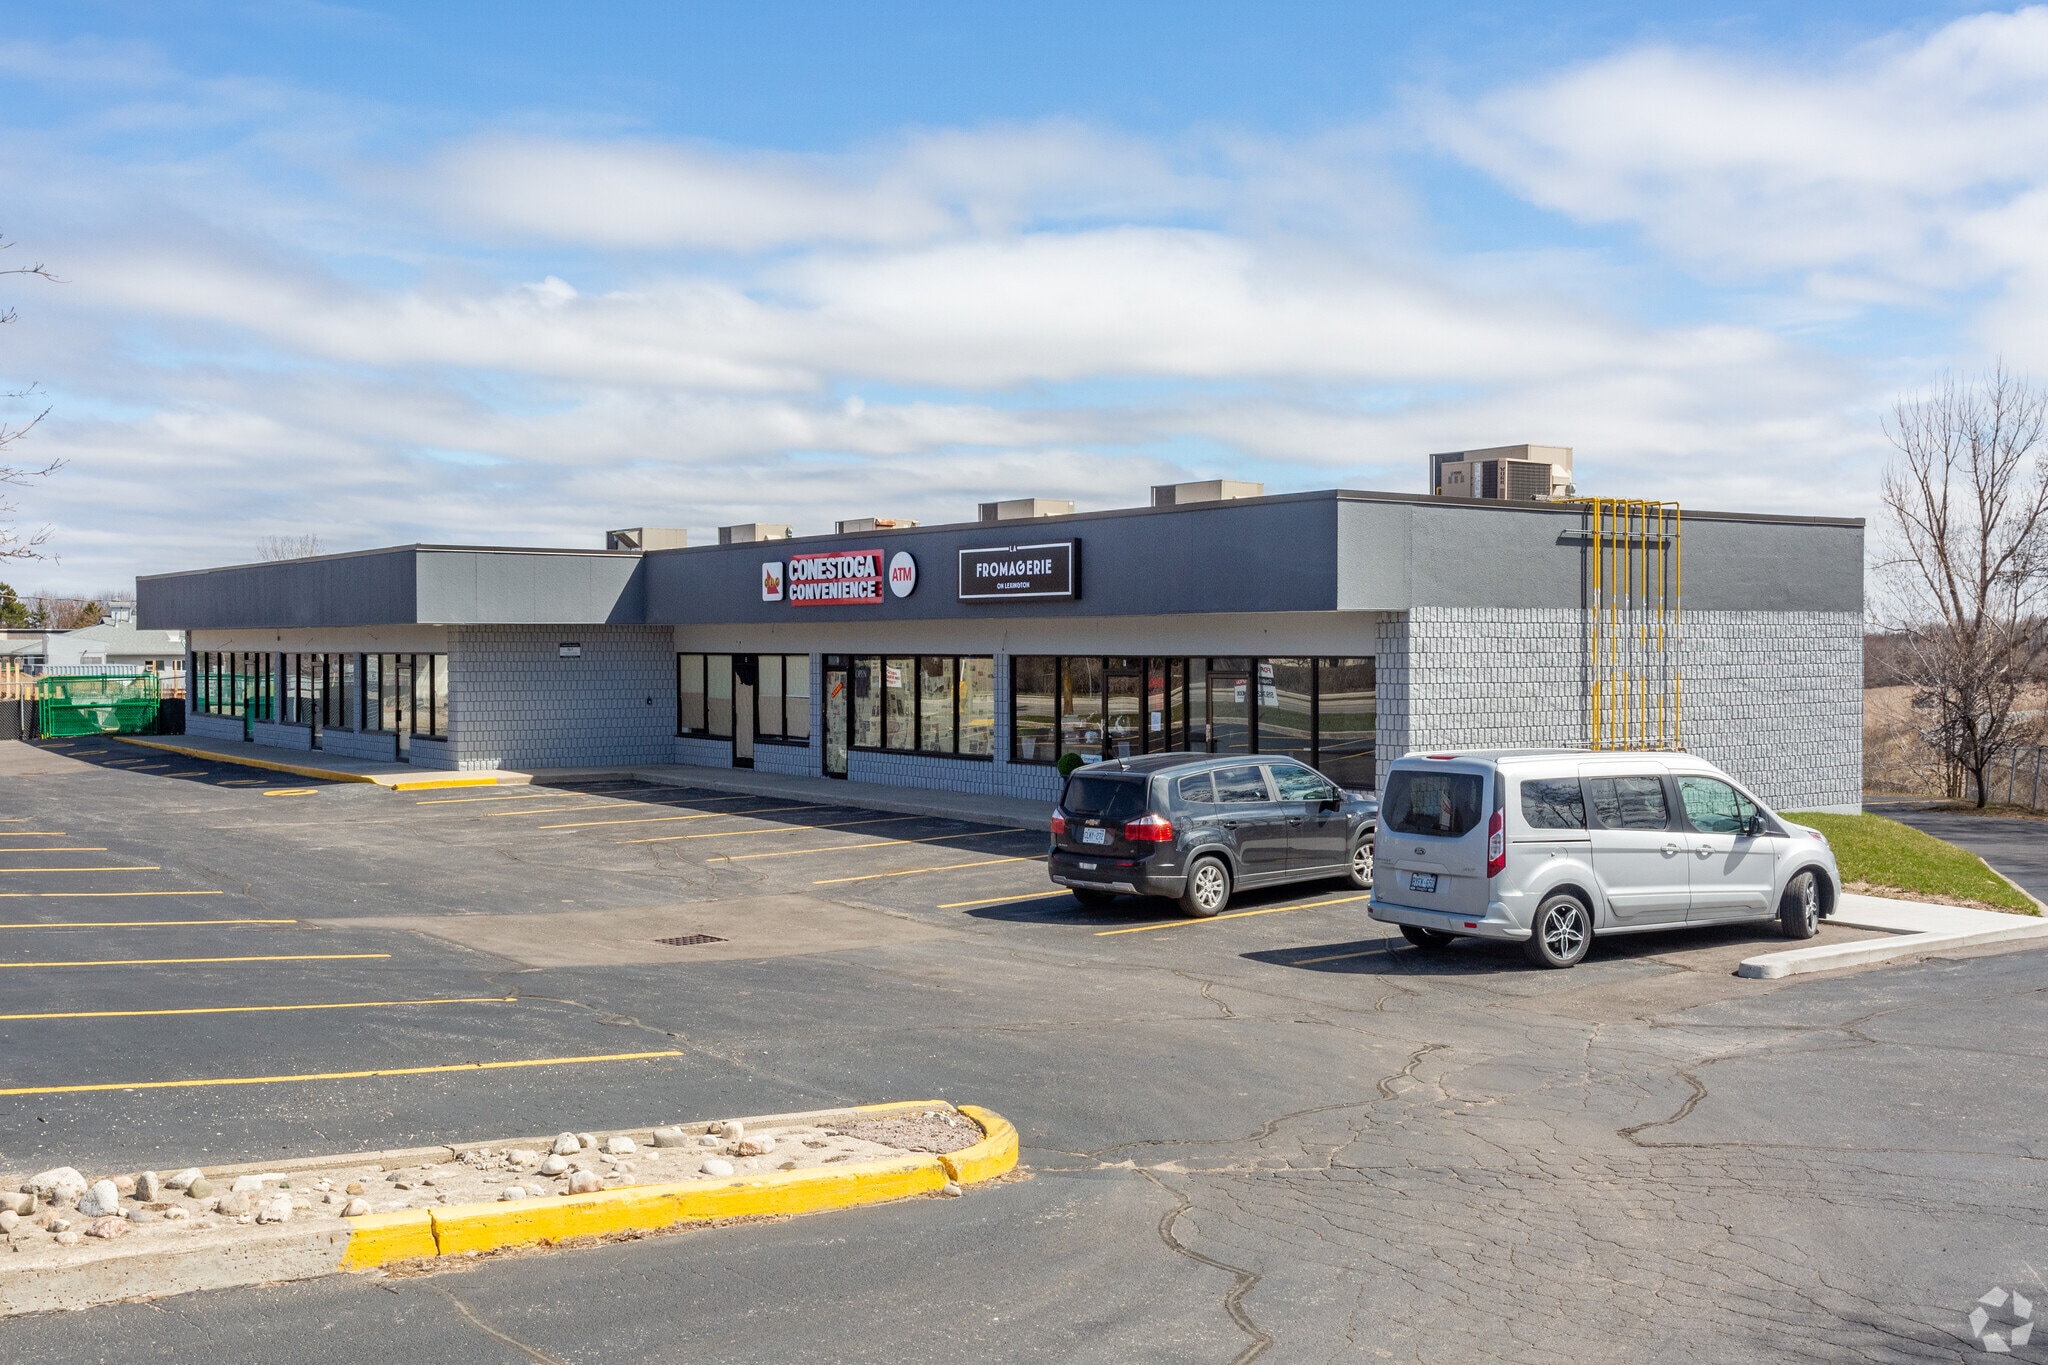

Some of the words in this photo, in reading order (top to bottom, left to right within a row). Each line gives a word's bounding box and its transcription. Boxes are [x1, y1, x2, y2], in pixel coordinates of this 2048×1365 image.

[1009, 545, 1017, 553] LA
[788, 555, 876, 581] CONESTOGA
[891, 566, 912, 582] ATM
[976, 559, 1052, 578] FROMAGERIE
[789, 580, 876, 600] CONVENIENCE
